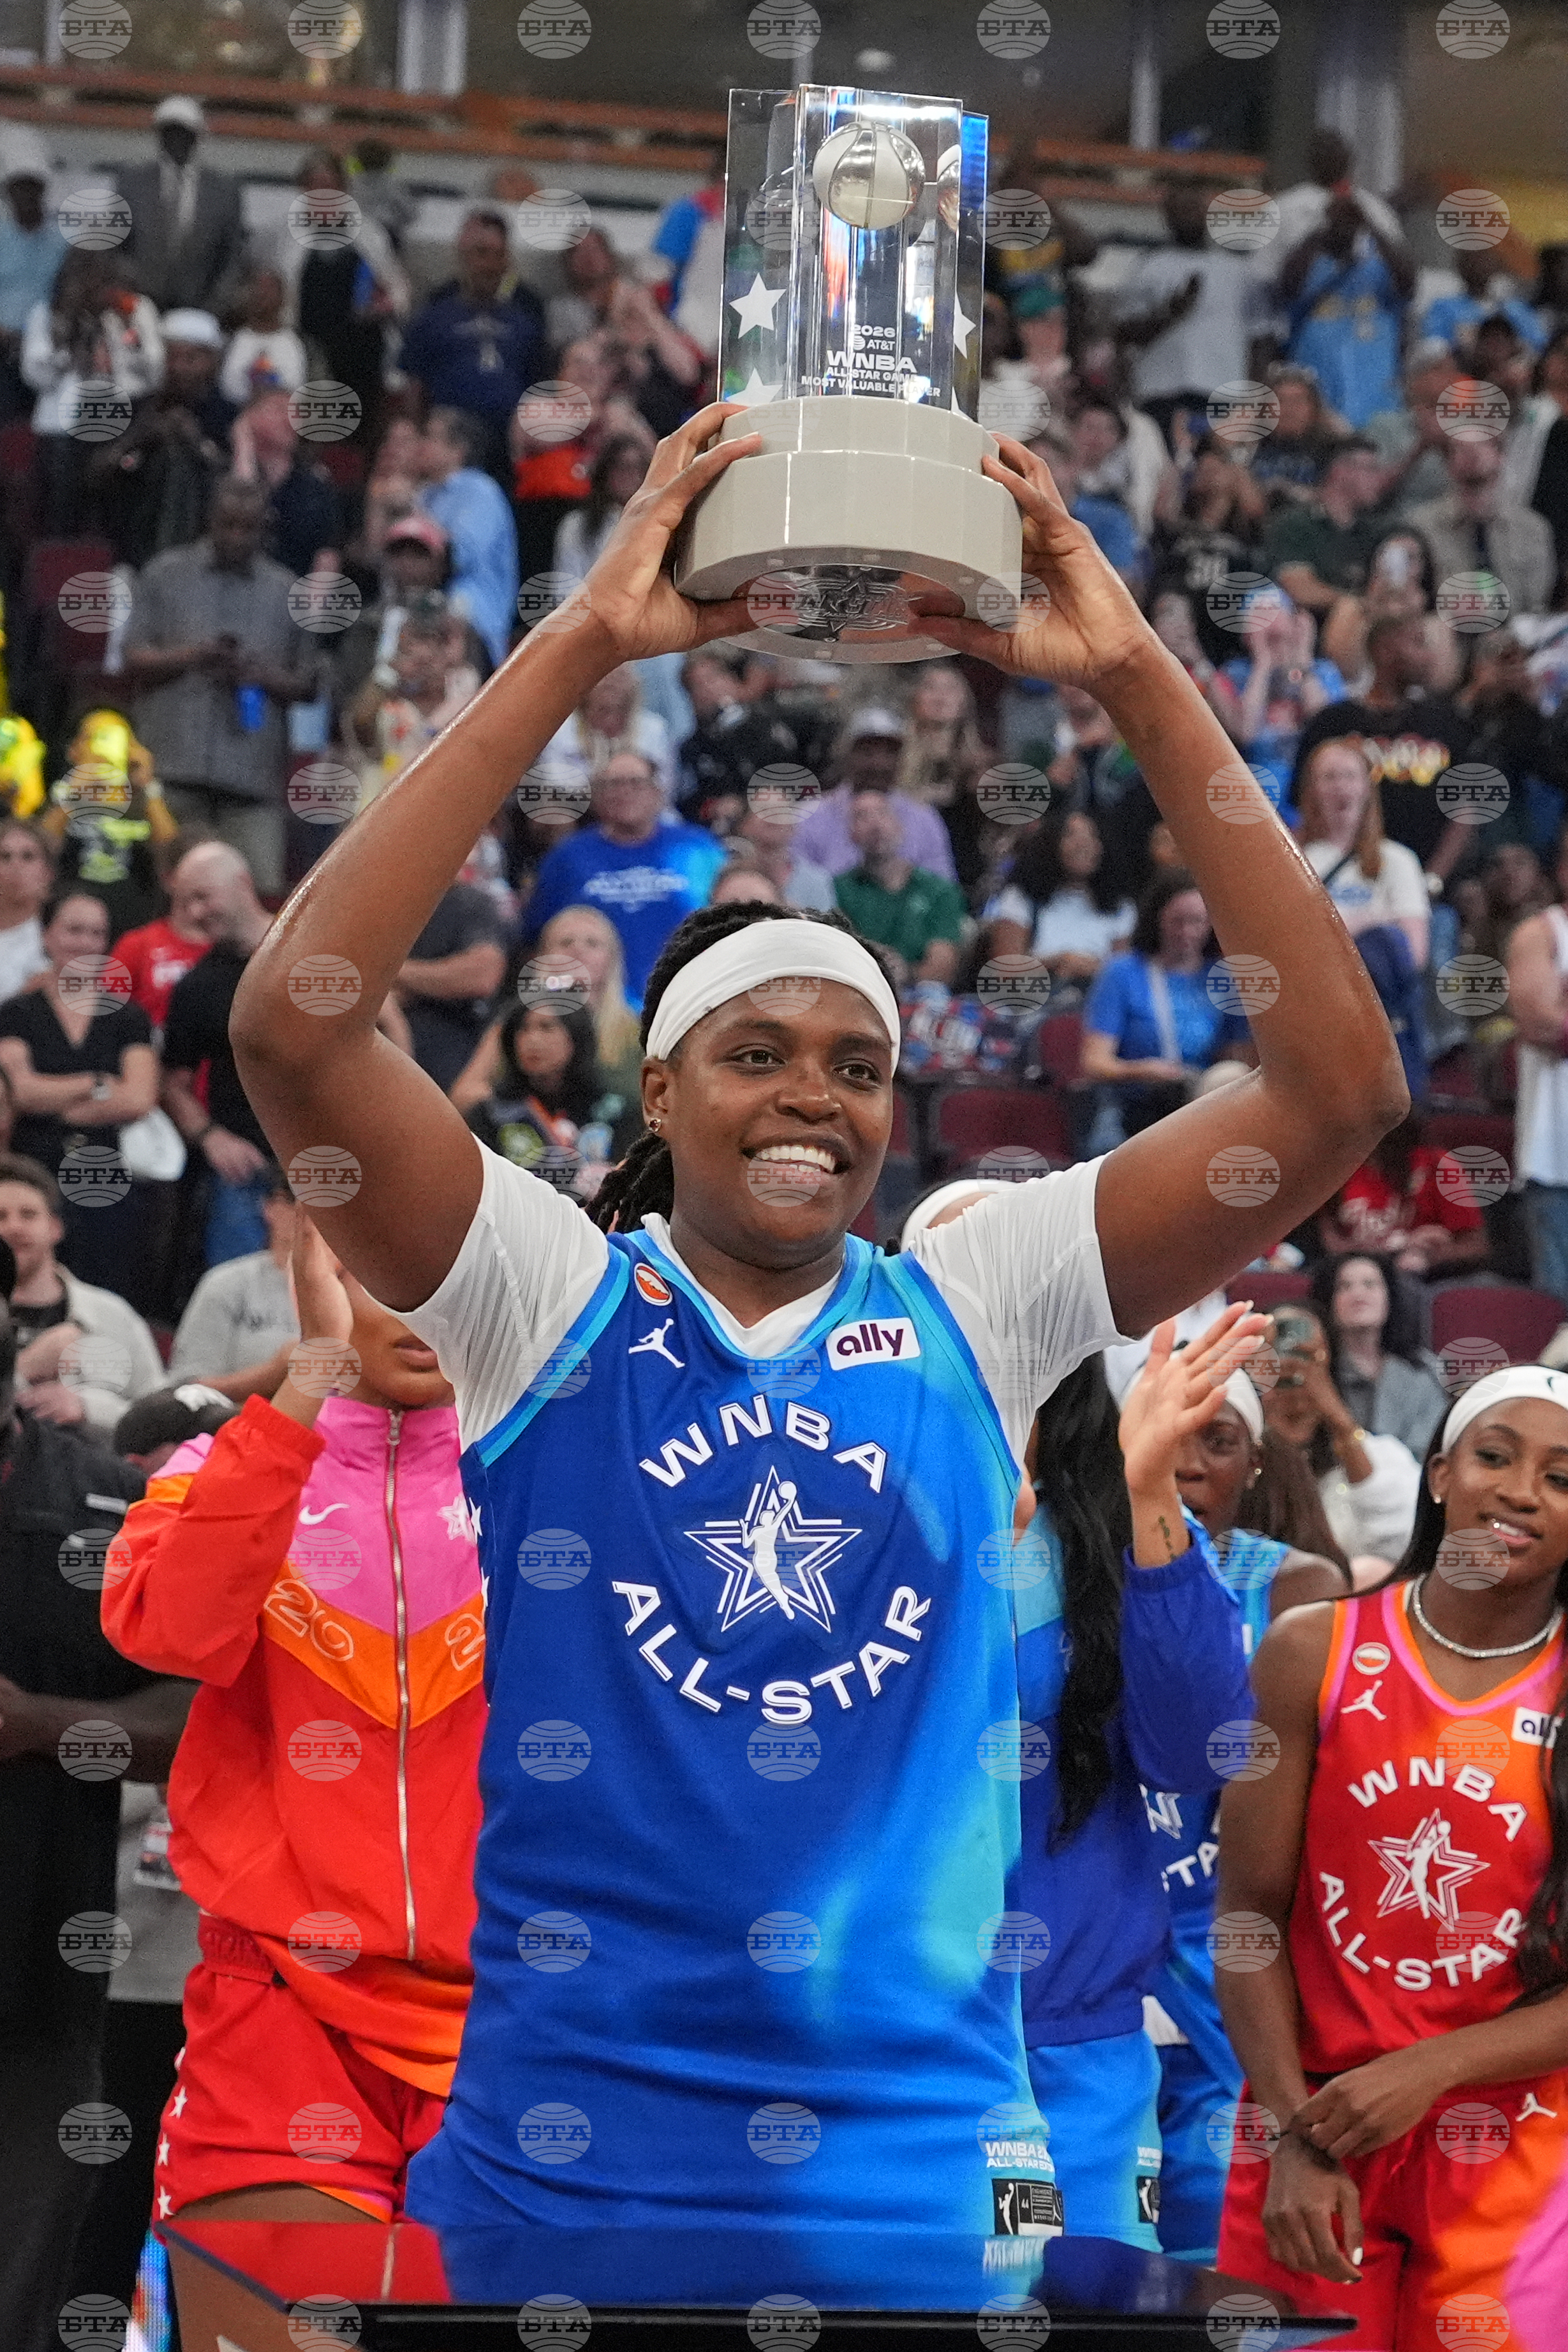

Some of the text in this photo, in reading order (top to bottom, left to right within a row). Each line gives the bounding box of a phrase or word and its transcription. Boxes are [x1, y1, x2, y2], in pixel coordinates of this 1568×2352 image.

[853, 324, 896, 338] 2026
[866, 339, 896, 351] AT&T
[827, 350, 918, 373] WNBA
[801, 375, 836, 387] MOST
[837, 378, 896, 393] VALUABLE
[836, 1323, 904, 1357] ally
[639, 1394, 887, 1494] WNBA
[263, 1578, 355, 1662] 20
[612, 1580, 932, 1725] ALL-STAR
[1347, 1756, 1528, 1842] WNBA
[1319, 1871, 1528, 1992] ALL-STAR
[986, 2141, 1037, 2157] WNBA
[986, 2157, 1039, 2169] ALL-STAR
